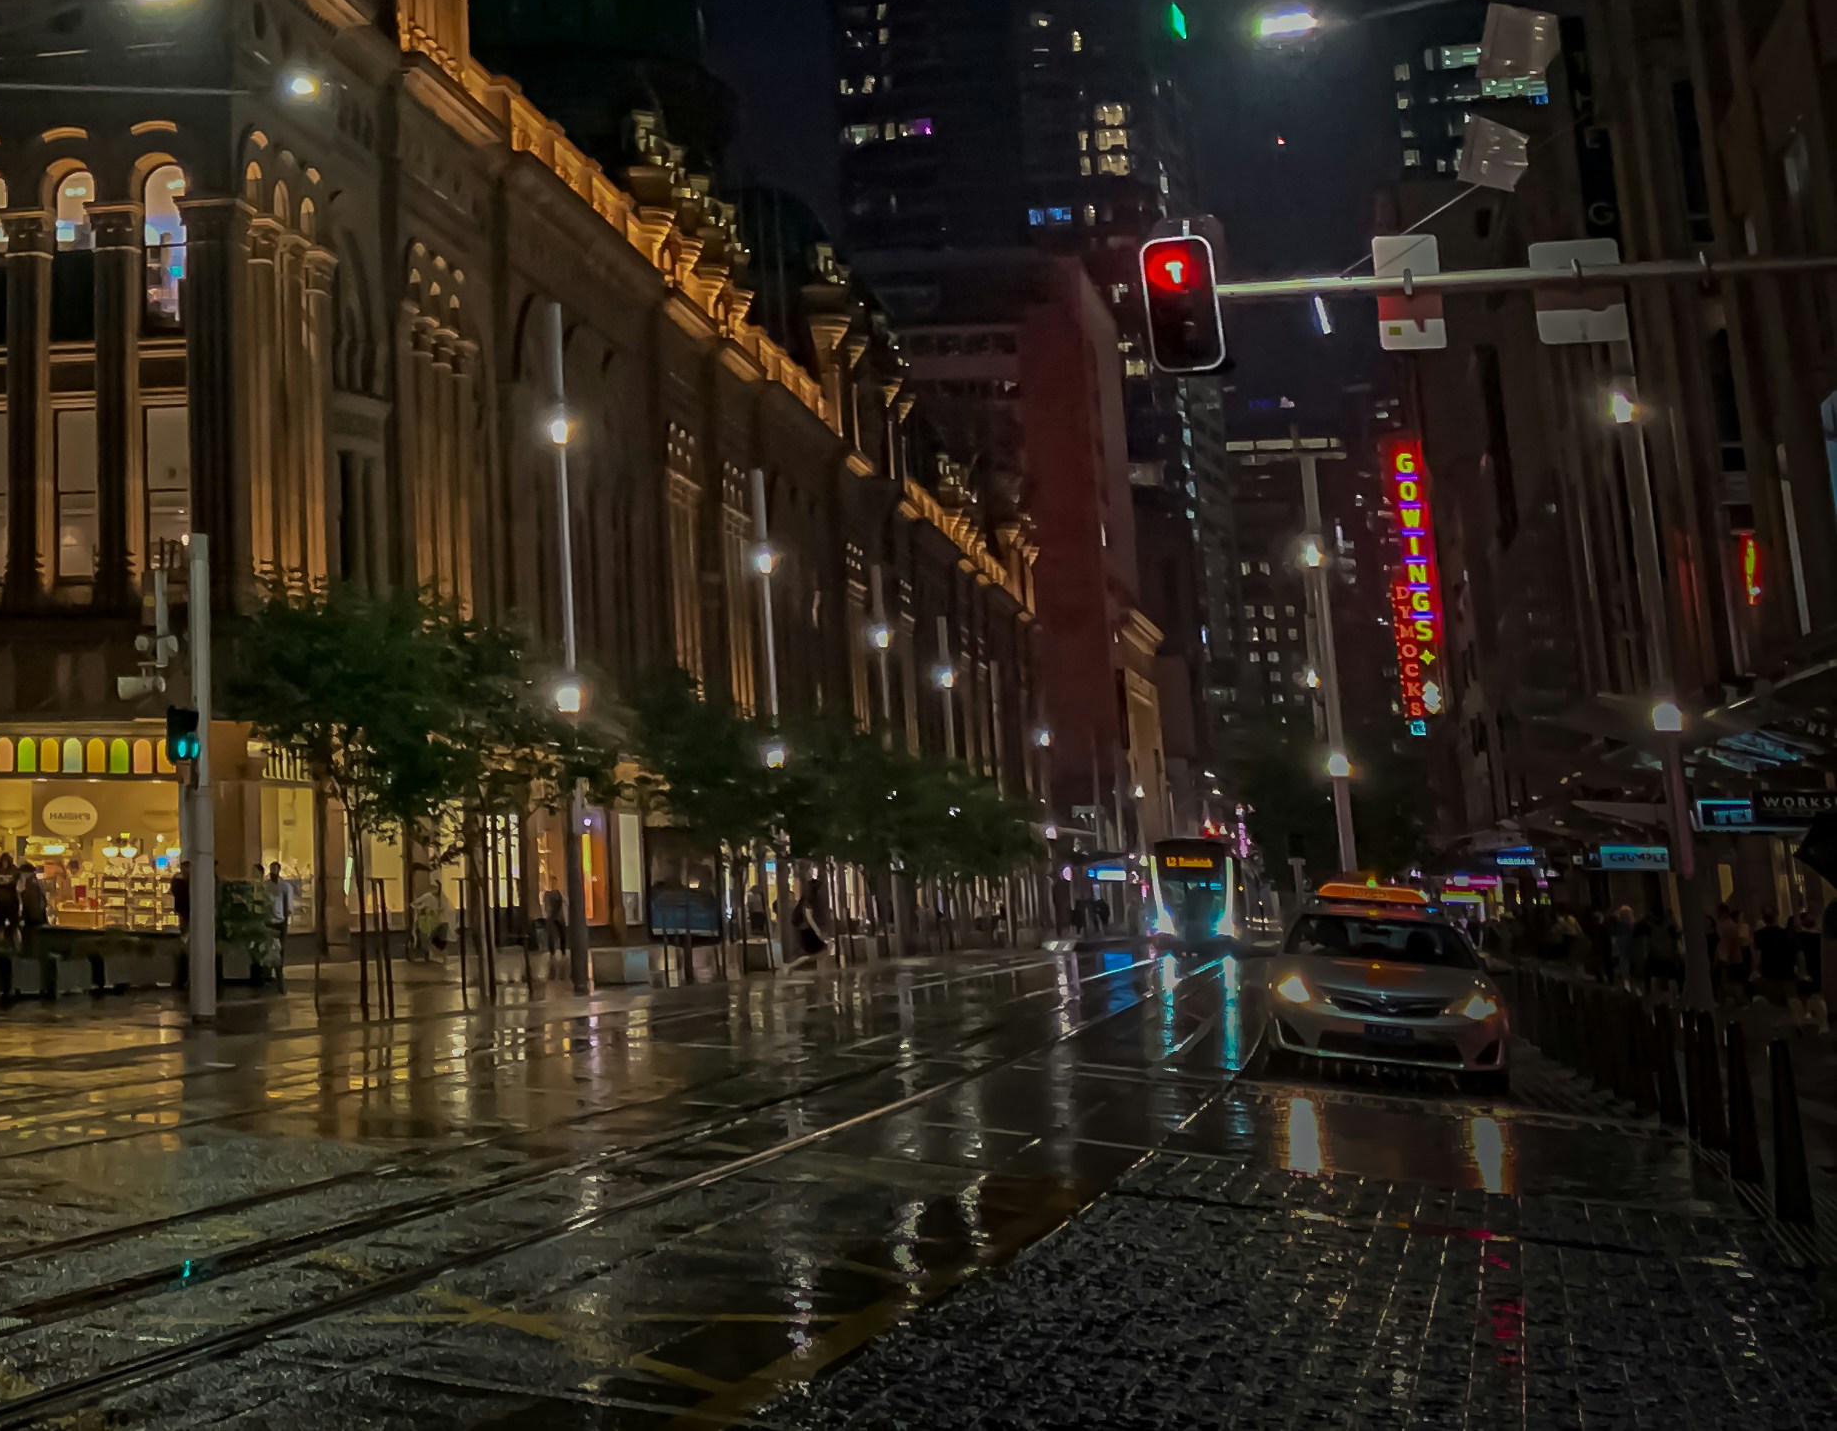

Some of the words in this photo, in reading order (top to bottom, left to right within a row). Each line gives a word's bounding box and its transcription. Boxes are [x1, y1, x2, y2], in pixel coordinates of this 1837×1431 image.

[1396, 453, 1433, 642] GOWINGS
[1395, 585, 1423, 717] DYMOCKS
[1762, 795, 1837, 810] WORKS
